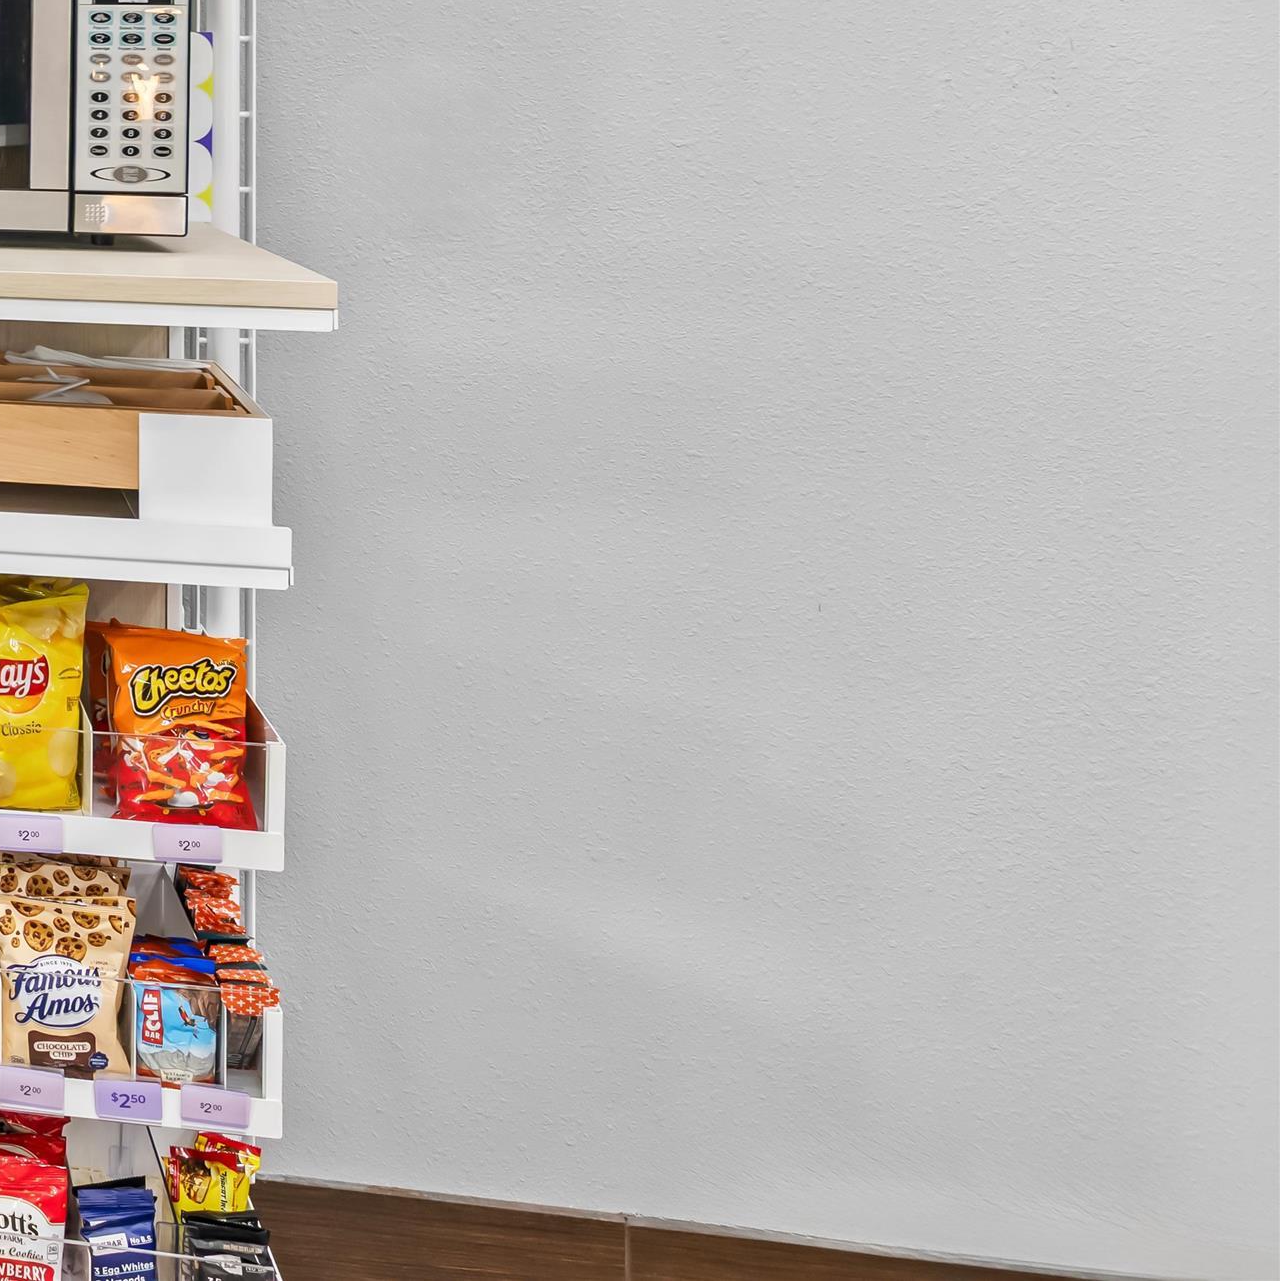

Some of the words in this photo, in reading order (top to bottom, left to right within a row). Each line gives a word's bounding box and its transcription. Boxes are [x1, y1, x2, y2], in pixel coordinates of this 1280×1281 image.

[133, 662, 233, 710] Cheetos
[160, 700, 215, 721] Crunchy
[1, 722, 42, 737] Classic
[40, 960, 58, 968] SINCE
[7, 963, 102, 1000] Famous
[15, 992, 100, 1024] Amos
[144, 1030, 160, 1039] BAR
[36, 1043, 88, 1051] CHOCOLATE
[3, 1235, 24, 1245] FARM
[8, 1247, 44, 1260] Cookies
[94, 1267, 100, 1275] 3
[102, 1266, 120, 1276] Egg
[121, 1262, 154, 1273] Whites
